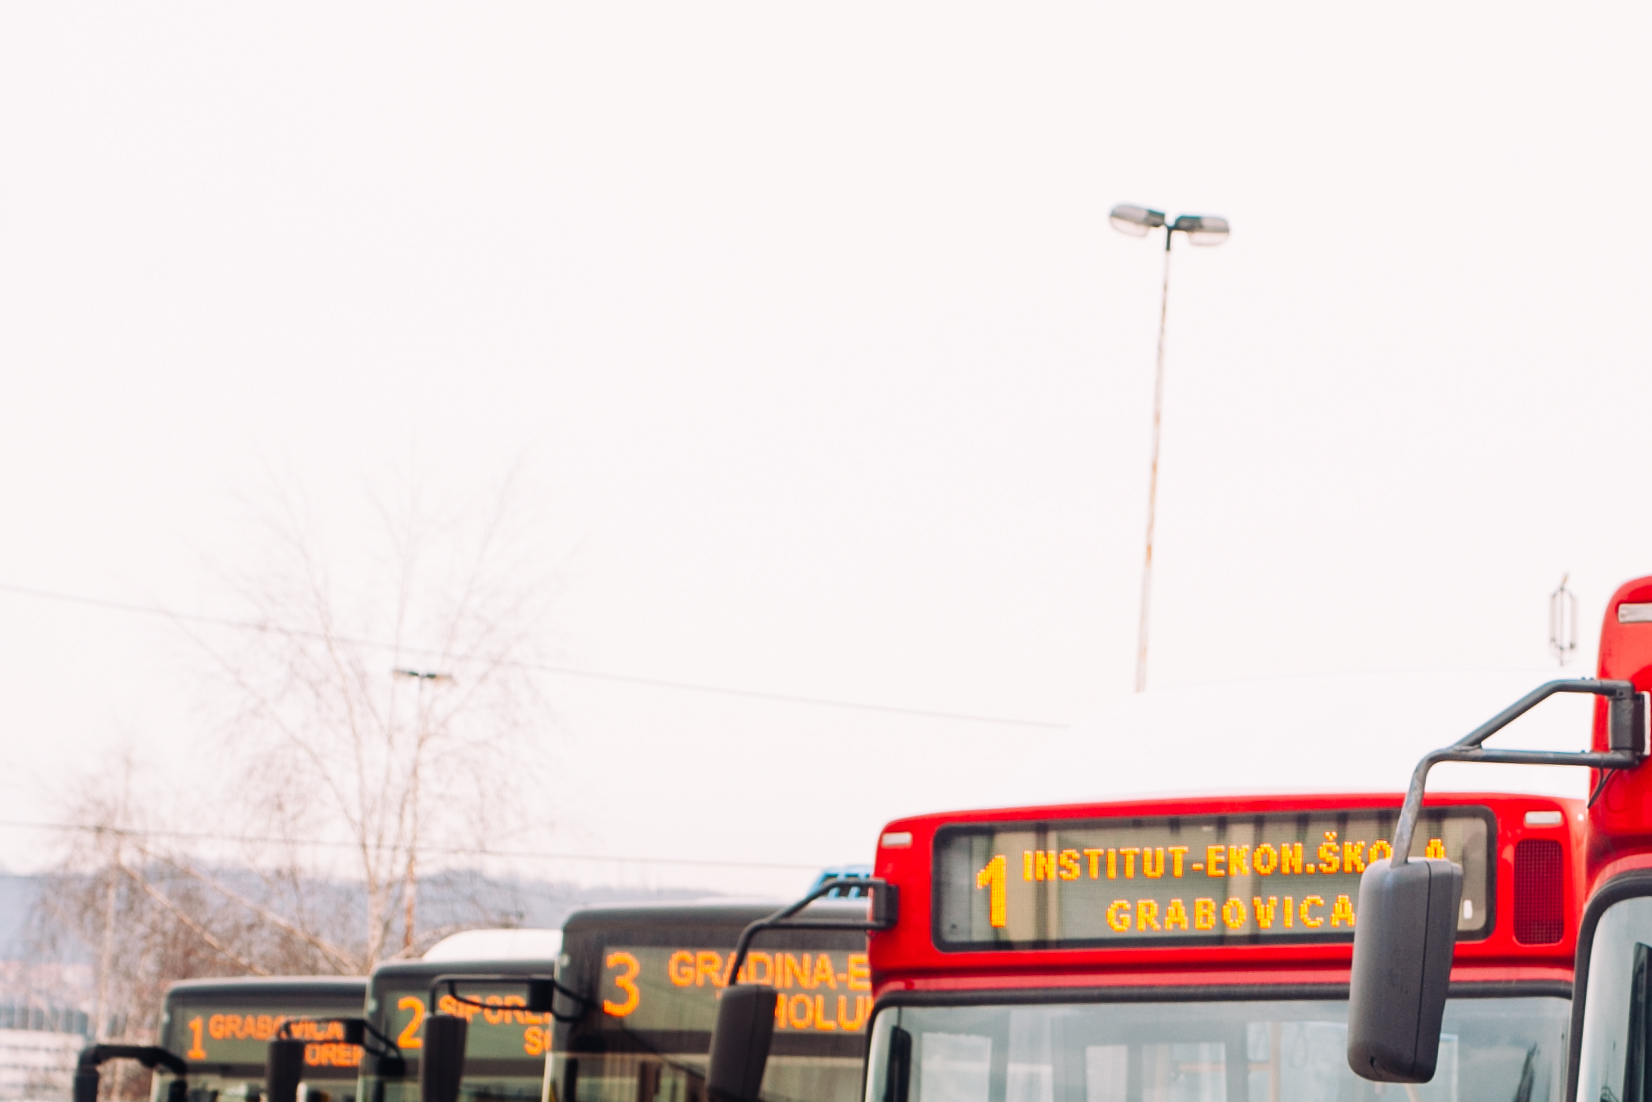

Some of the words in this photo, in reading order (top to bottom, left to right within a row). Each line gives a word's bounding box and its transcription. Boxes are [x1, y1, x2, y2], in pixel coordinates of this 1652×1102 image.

[976, 854, 1008, 928] 1
[1106, 895, 1356, 932] GRABOVICA
[603, 951, 641, 1018] 3
[187, 1016, 207, 1060] 1
[397, 996, 425, 1049] 2
